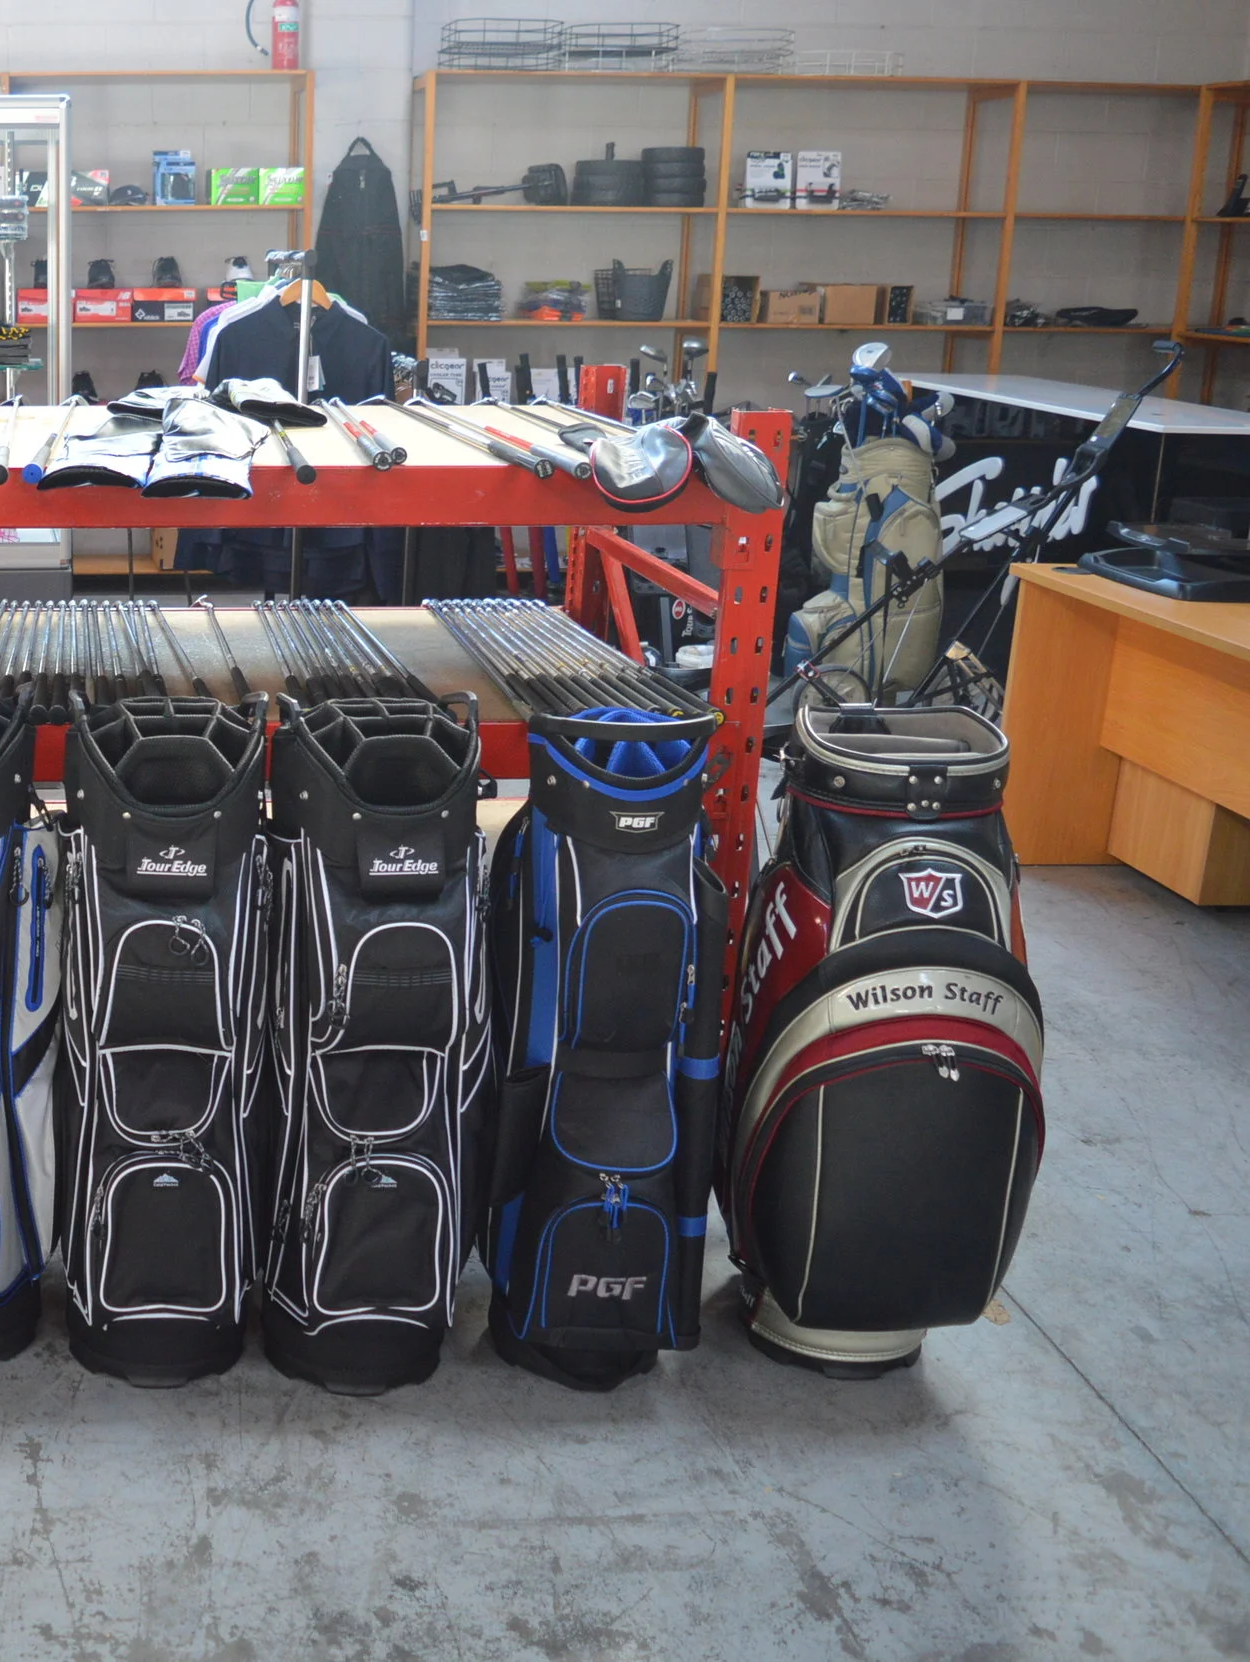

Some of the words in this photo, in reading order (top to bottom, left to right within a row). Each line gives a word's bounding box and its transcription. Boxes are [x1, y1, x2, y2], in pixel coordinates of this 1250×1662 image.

[430, 361, 465, 370] clicgear
[618, 816, 656, 829] PGF
[741, 880, 798, 1025] Staff
[846, 983, 934, 1012] Wilson
[943, 981, 1004, 1016] Staff
[567, 1273, 647, 1300] PGF
